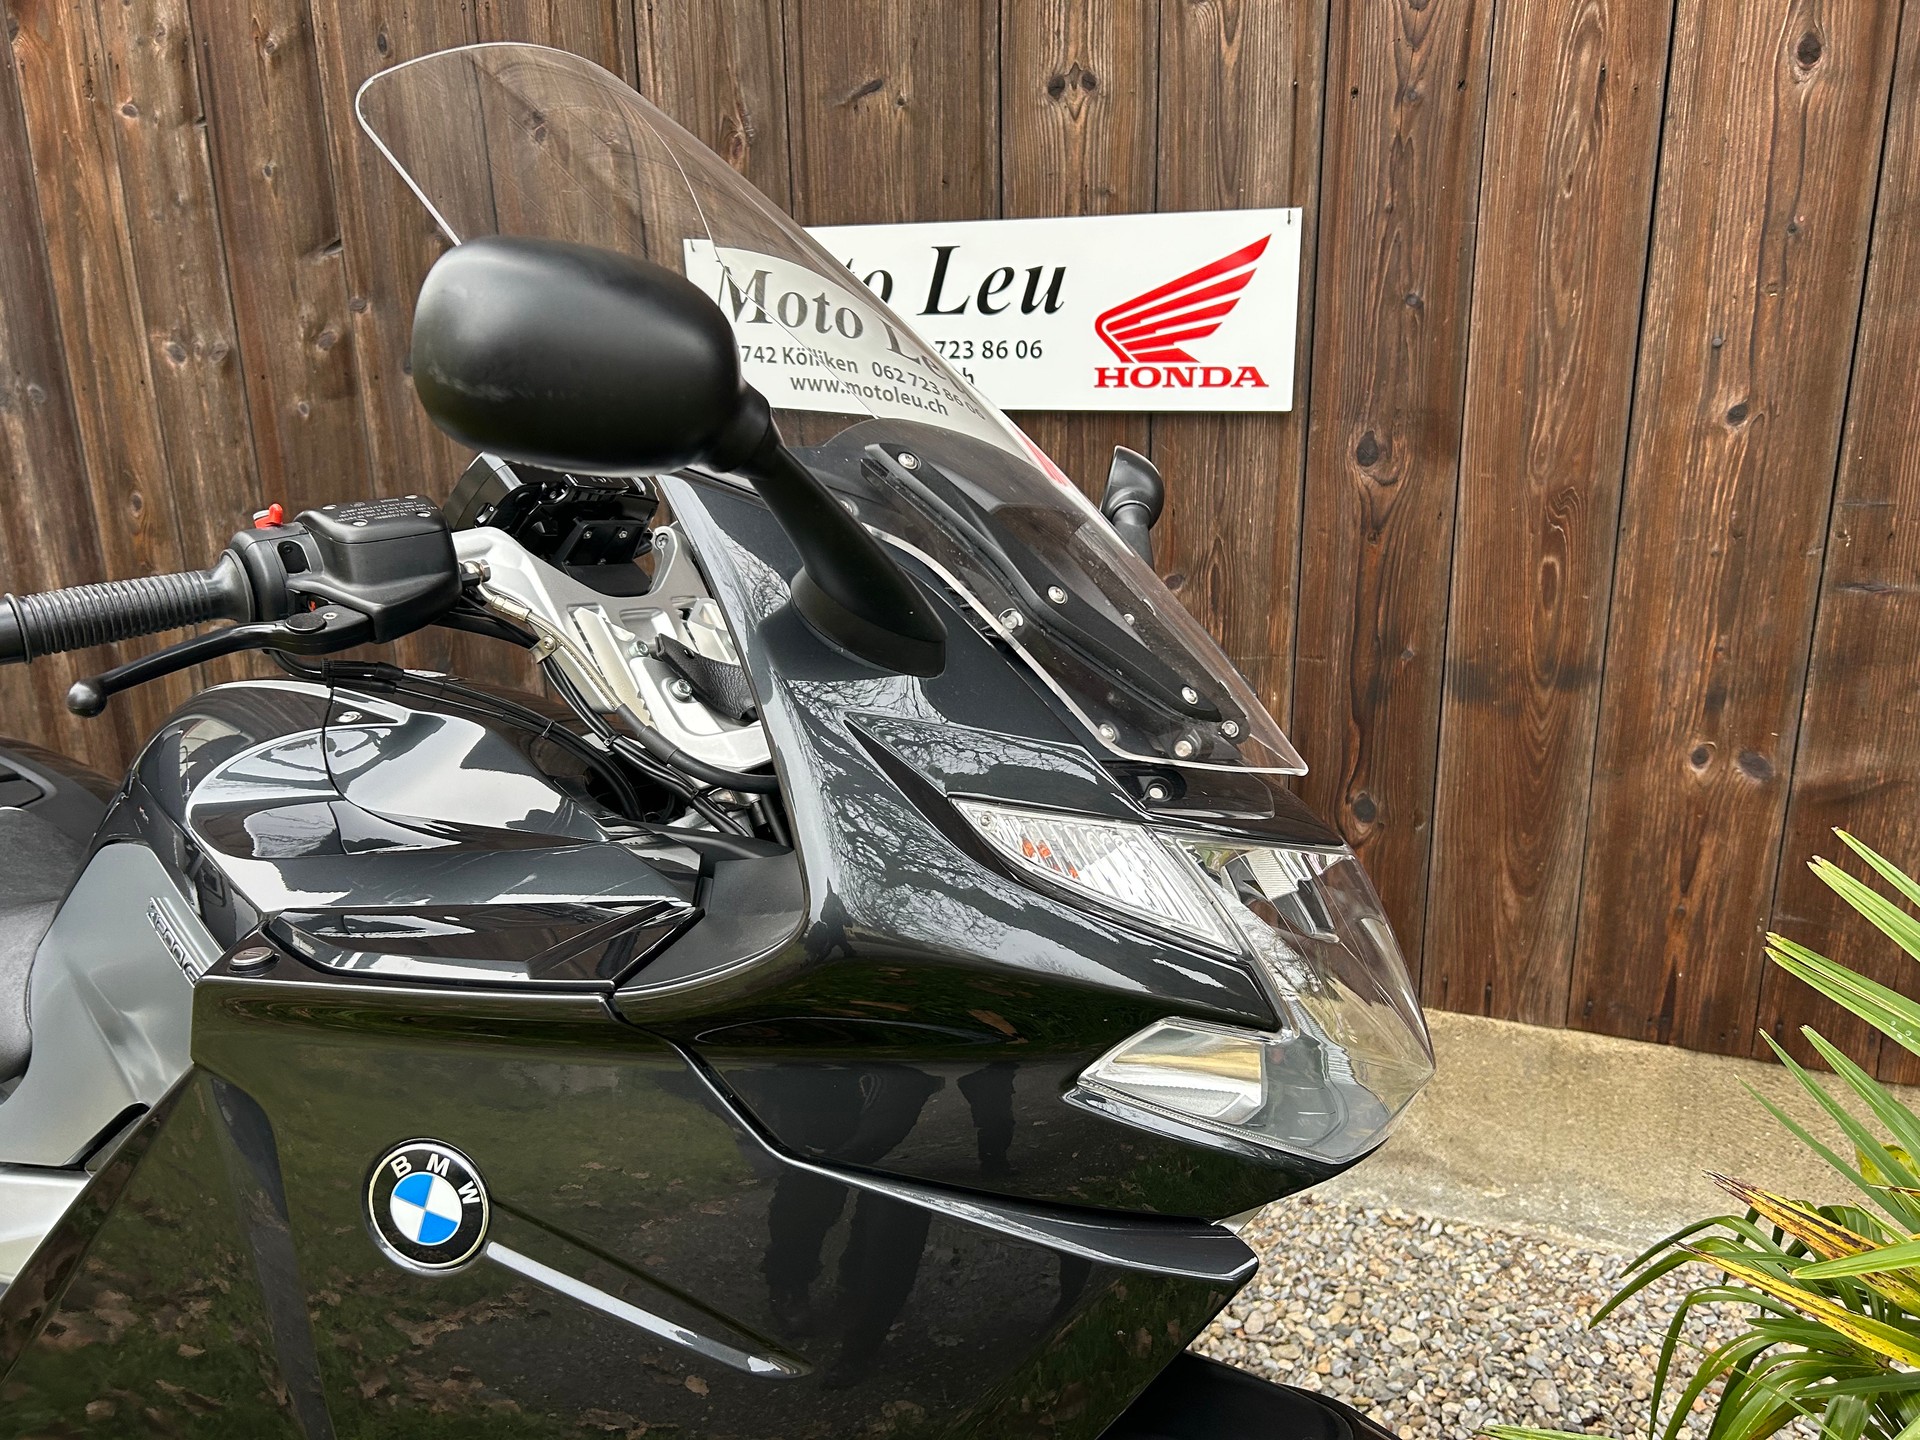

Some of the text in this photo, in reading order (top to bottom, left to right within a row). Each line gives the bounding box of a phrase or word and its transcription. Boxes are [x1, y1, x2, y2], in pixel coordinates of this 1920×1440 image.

[716, 260, 864, 339] Moto
[916, 245, 1068, 316] Leu
[738, 345, 777, 364] 742
[782, 346, 859, 374] Kölliken
[871, 361, 906, 384] 062
[908, 372, 941, 396] 723
[935, 339, 1043, 360] 723 86 06
[790, 377, 949, 416] www.motoleu.ch
[1093, 366, 1270, 389] HONDA
[390, 1153, 481, 1205] BMW
